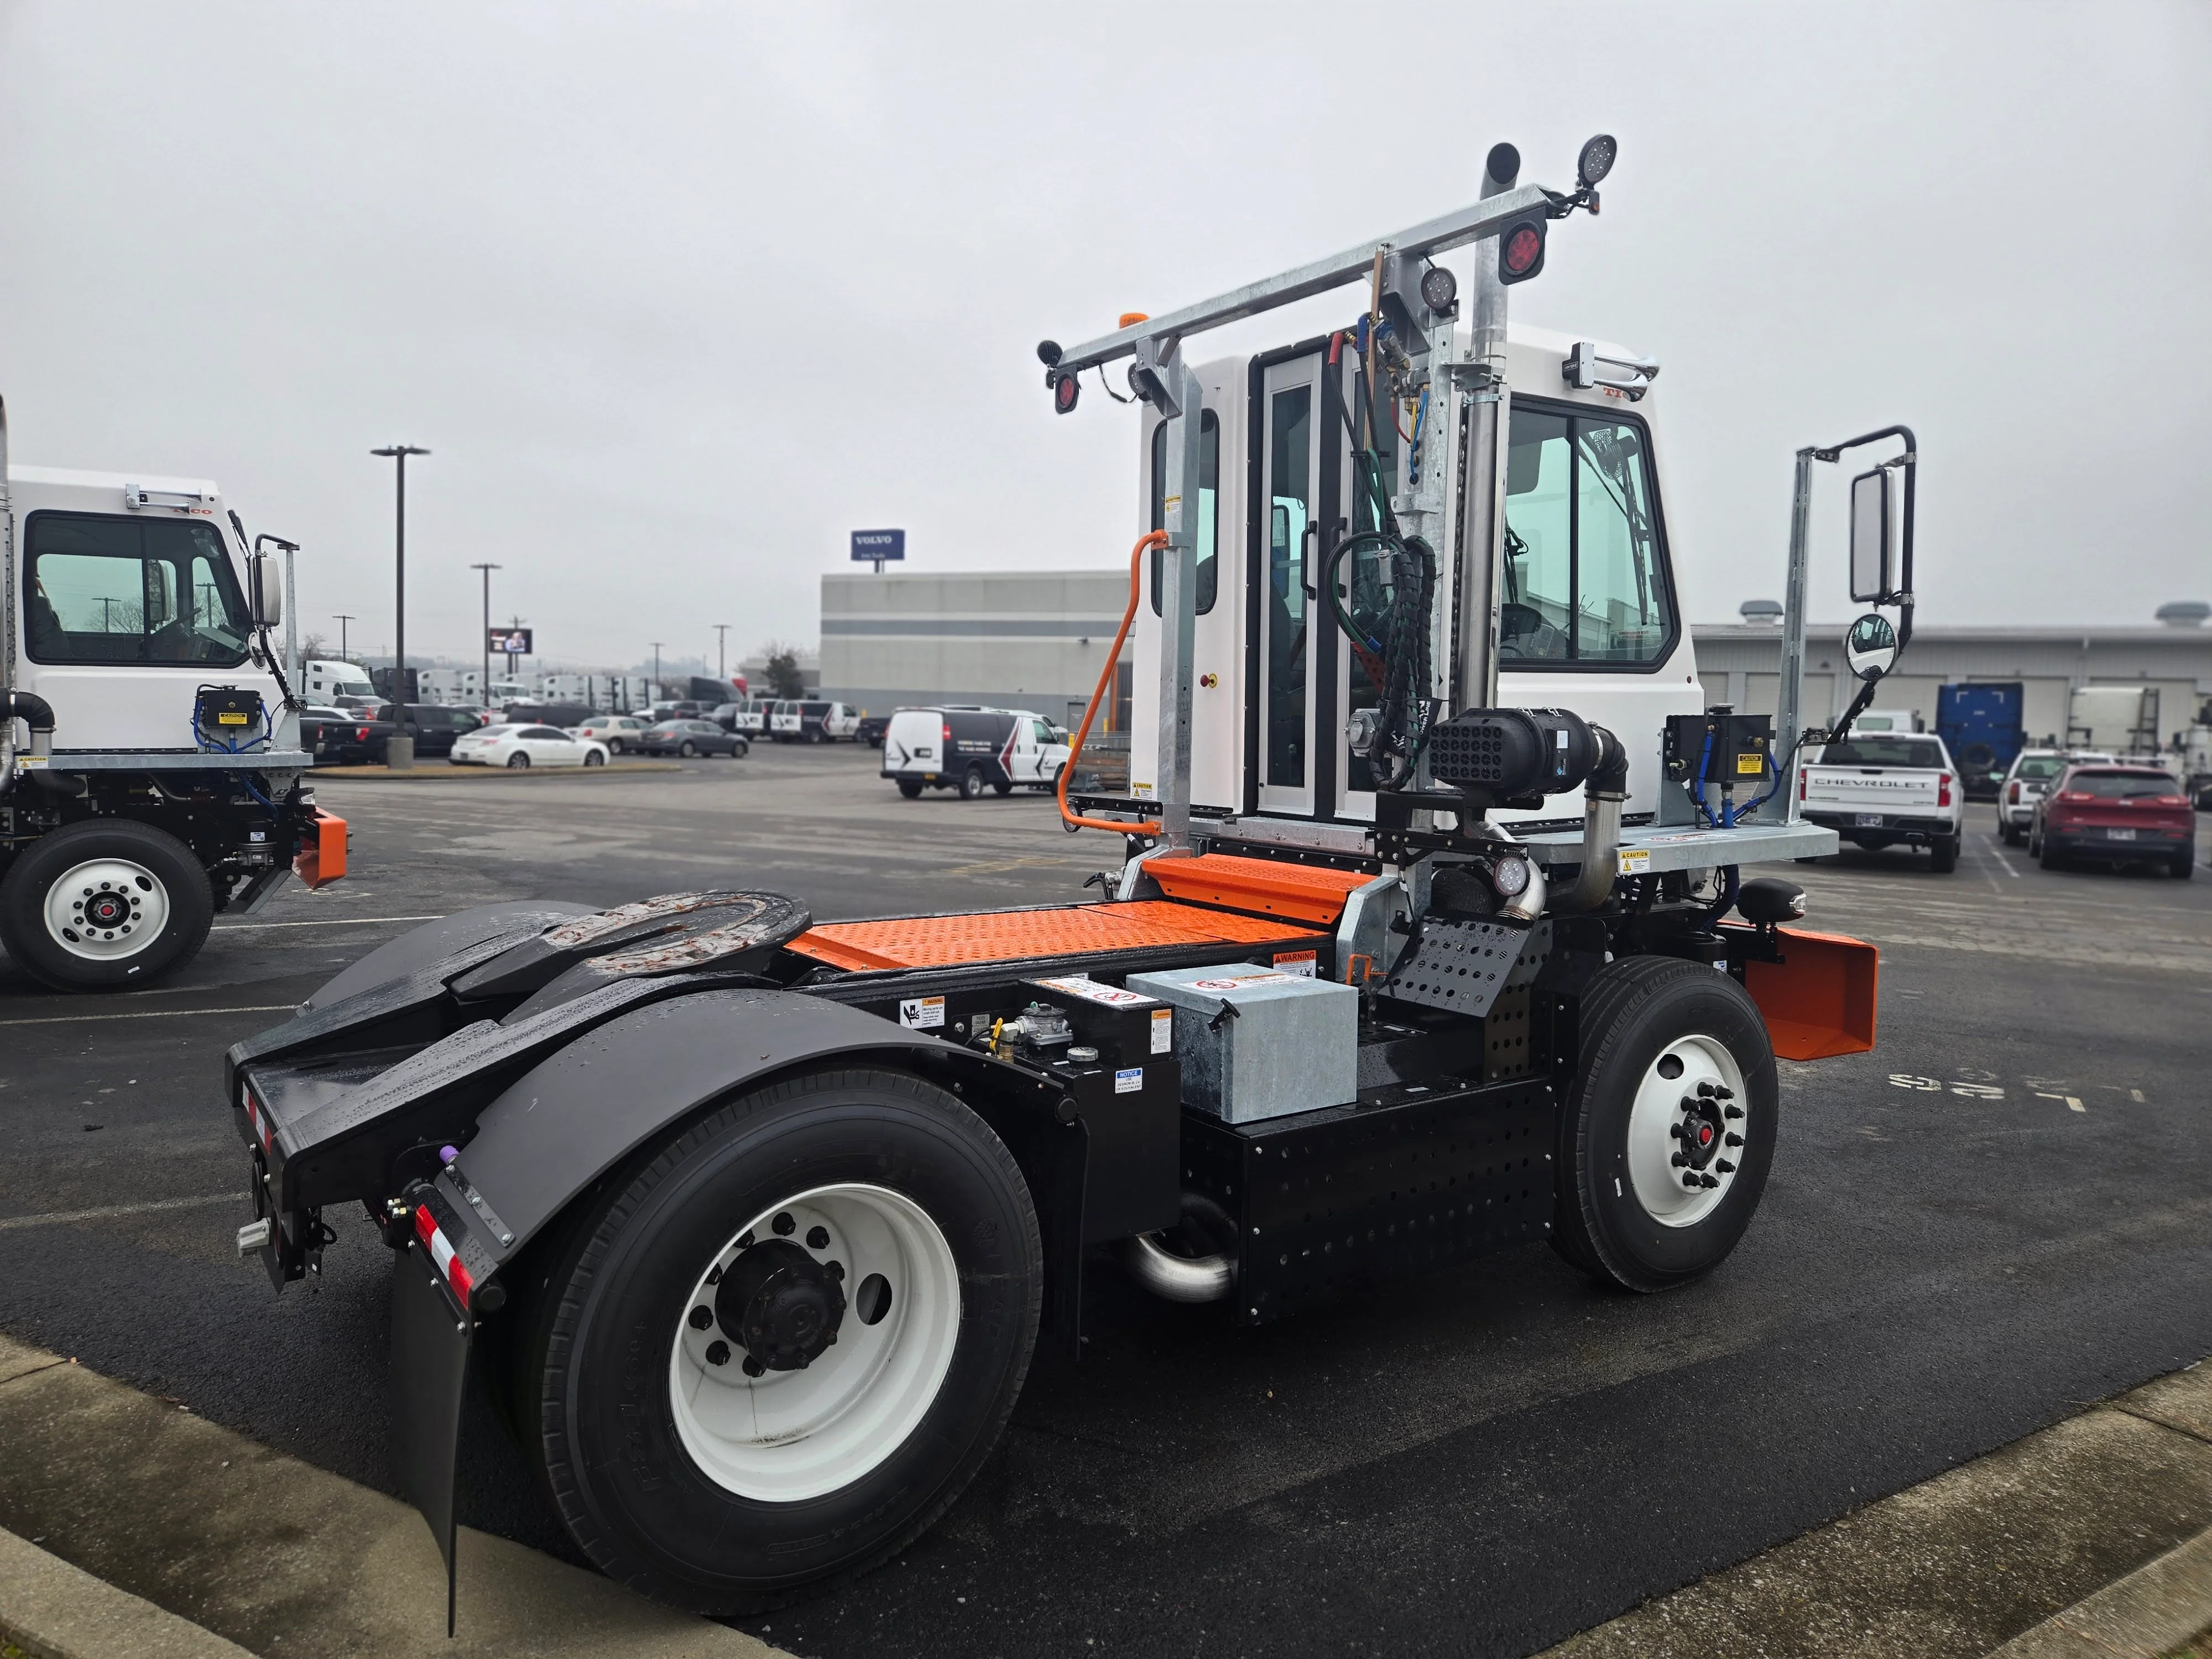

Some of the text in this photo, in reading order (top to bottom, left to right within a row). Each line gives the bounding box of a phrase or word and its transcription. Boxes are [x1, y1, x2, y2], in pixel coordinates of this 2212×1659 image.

[855, 535, 892, 545] VOLVO
[1420, 717, 1428, 735] OWER
[1815, 779, 1929, 789] CHEVROLET
[1281, 952, 1314, 962] WARNING
